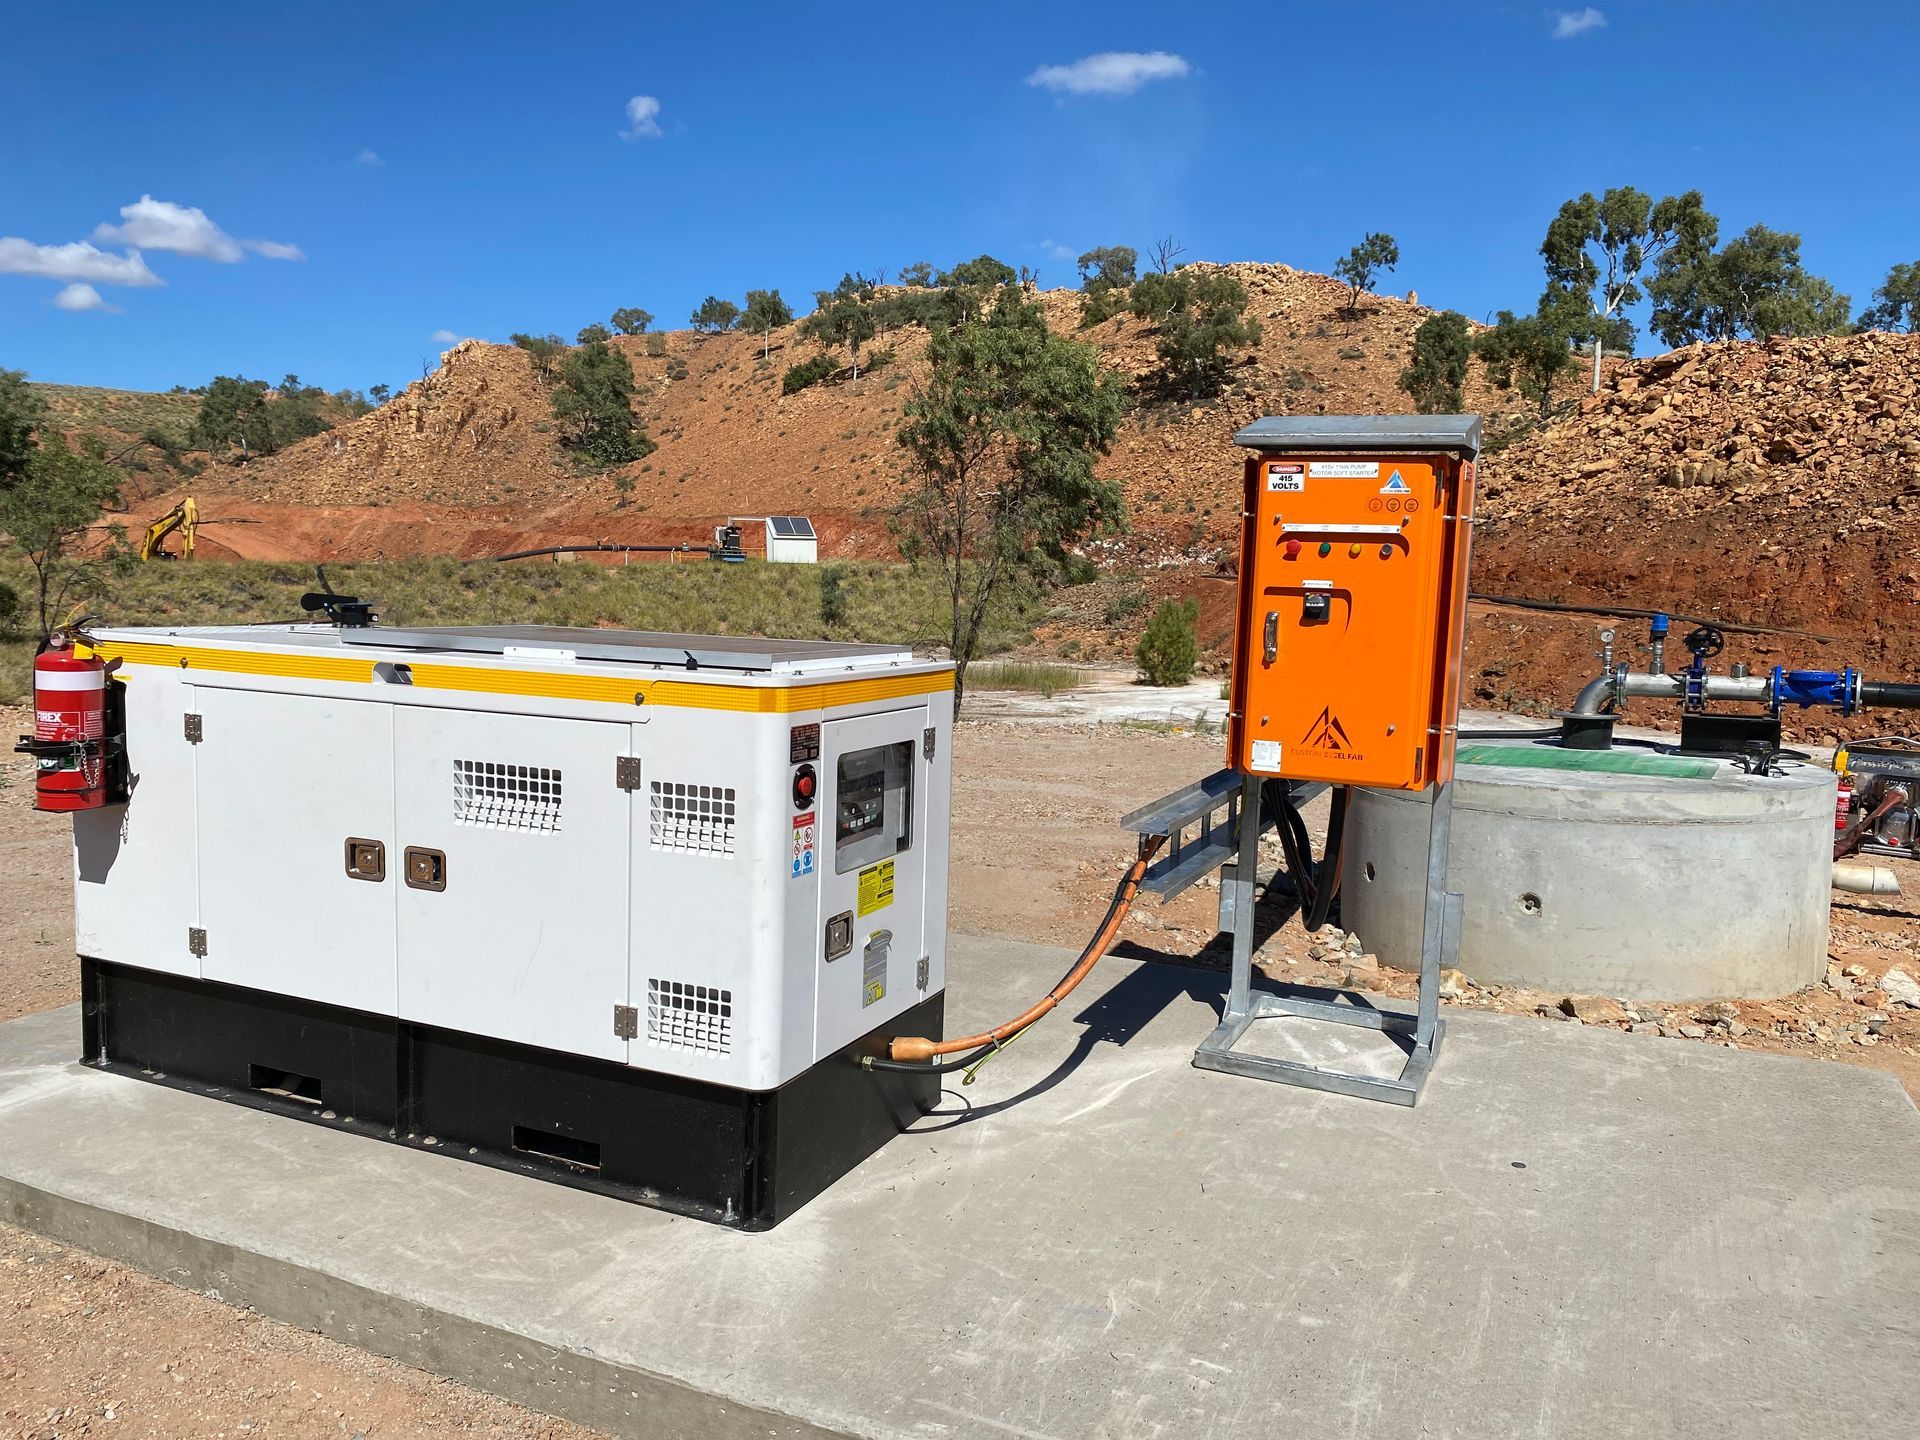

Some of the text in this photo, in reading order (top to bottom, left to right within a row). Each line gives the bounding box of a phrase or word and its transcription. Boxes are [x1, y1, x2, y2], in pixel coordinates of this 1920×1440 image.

[1272, 482, 1299, 490] VOLTS
[37, 711, 62, 722] FIREX
[1347, 753, 1363, 761] FAB
